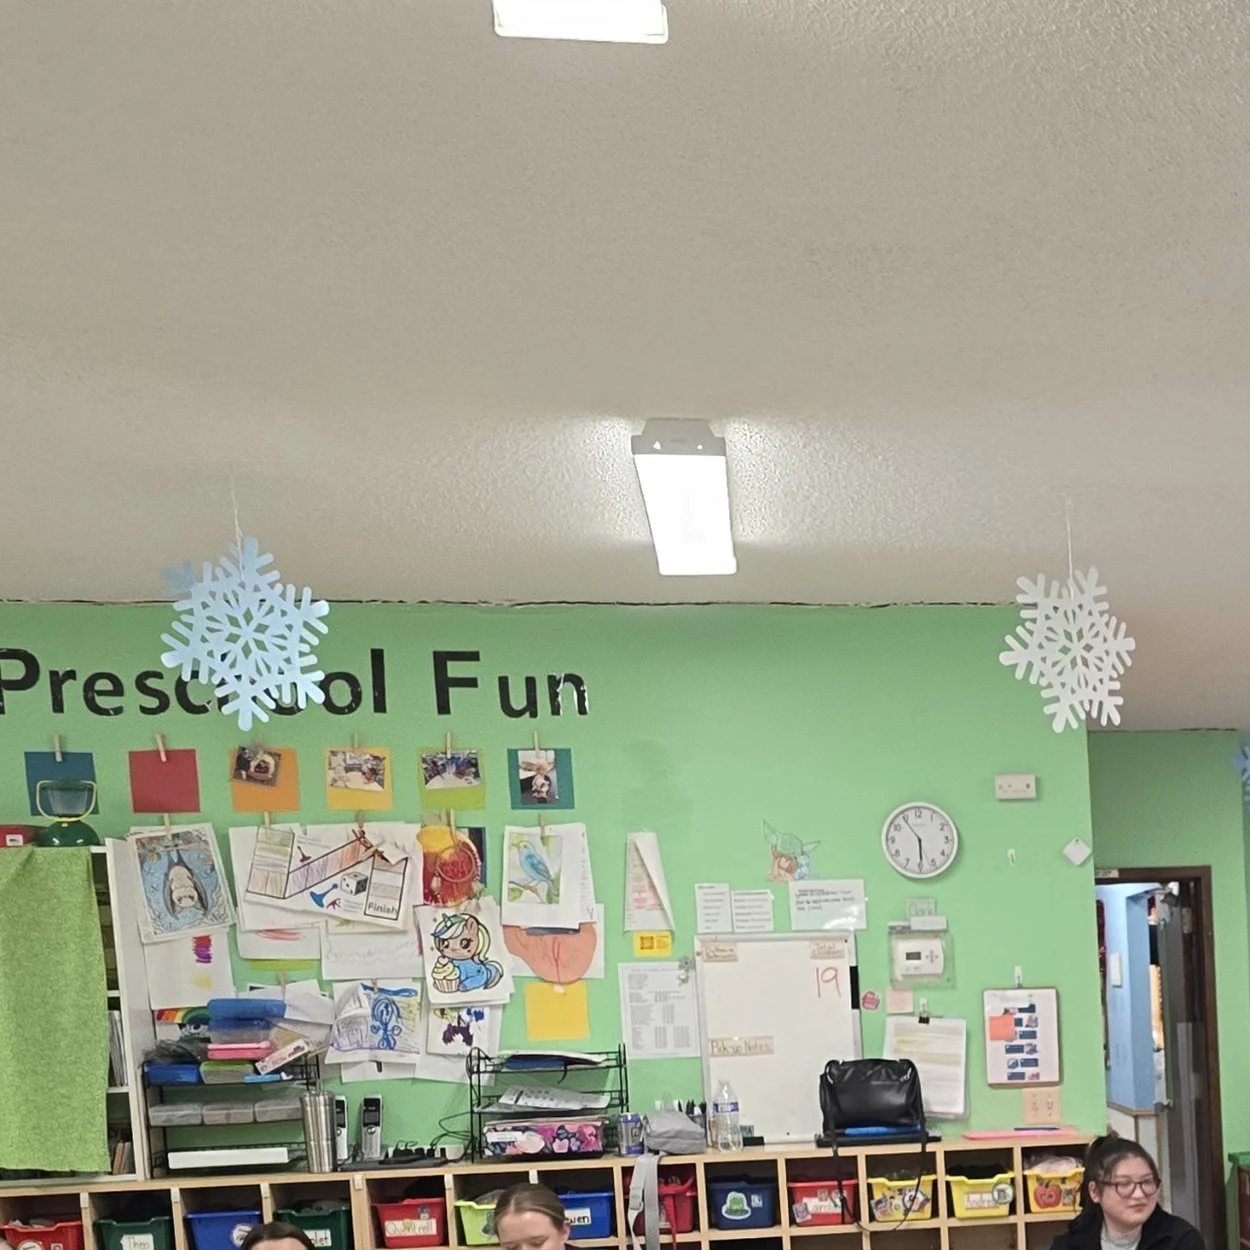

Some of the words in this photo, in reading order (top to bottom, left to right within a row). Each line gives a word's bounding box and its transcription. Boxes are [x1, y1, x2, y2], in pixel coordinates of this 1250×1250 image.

[433, 649, 588, 718] Fun
[367, 902, 398, 915] Finish
[816, 966, 841, 998] 19
